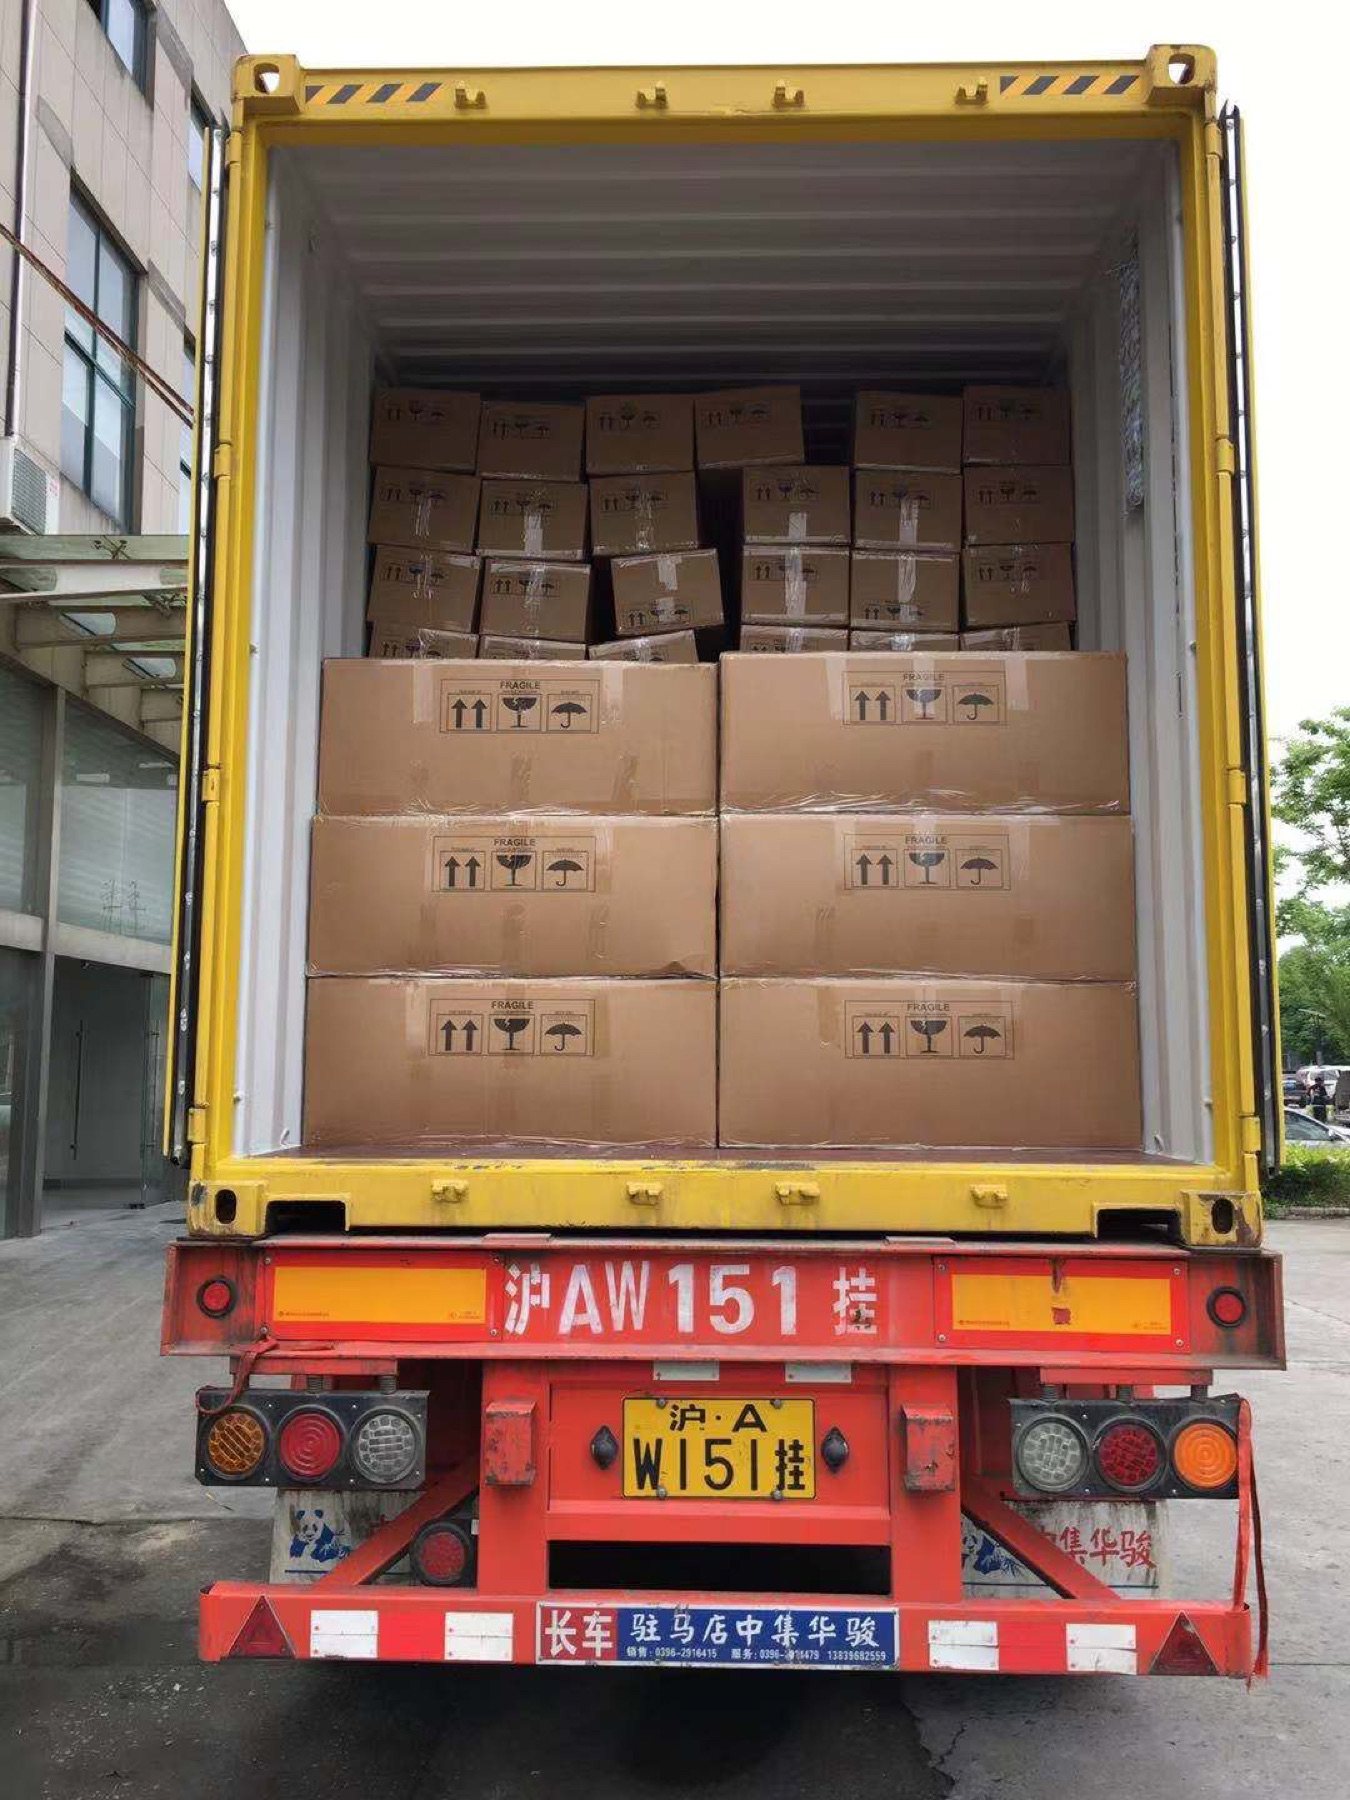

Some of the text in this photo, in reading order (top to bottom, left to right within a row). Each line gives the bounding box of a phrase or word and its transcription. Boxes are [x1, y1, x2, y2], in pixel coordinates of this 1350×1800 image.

[903, 673, 945, 681] FRAGILE
[500, 680, 541, 689] FRAGILE
[493, 838, 536, 847] FRAGILE
[905, 836, 948, 844] FRAGILE
[491, 1001, 535, 1010] FRAGILE
[907, 1003, 950, 1011] FRAGILE
[632, 1437, 806, 1491] W151挂
[1040, 1525, 1157, 1570] 集华骏
[544, 1609, 613, 1659] 长车
[630, 1613, 880, 1648] 驻马店中集华骏
